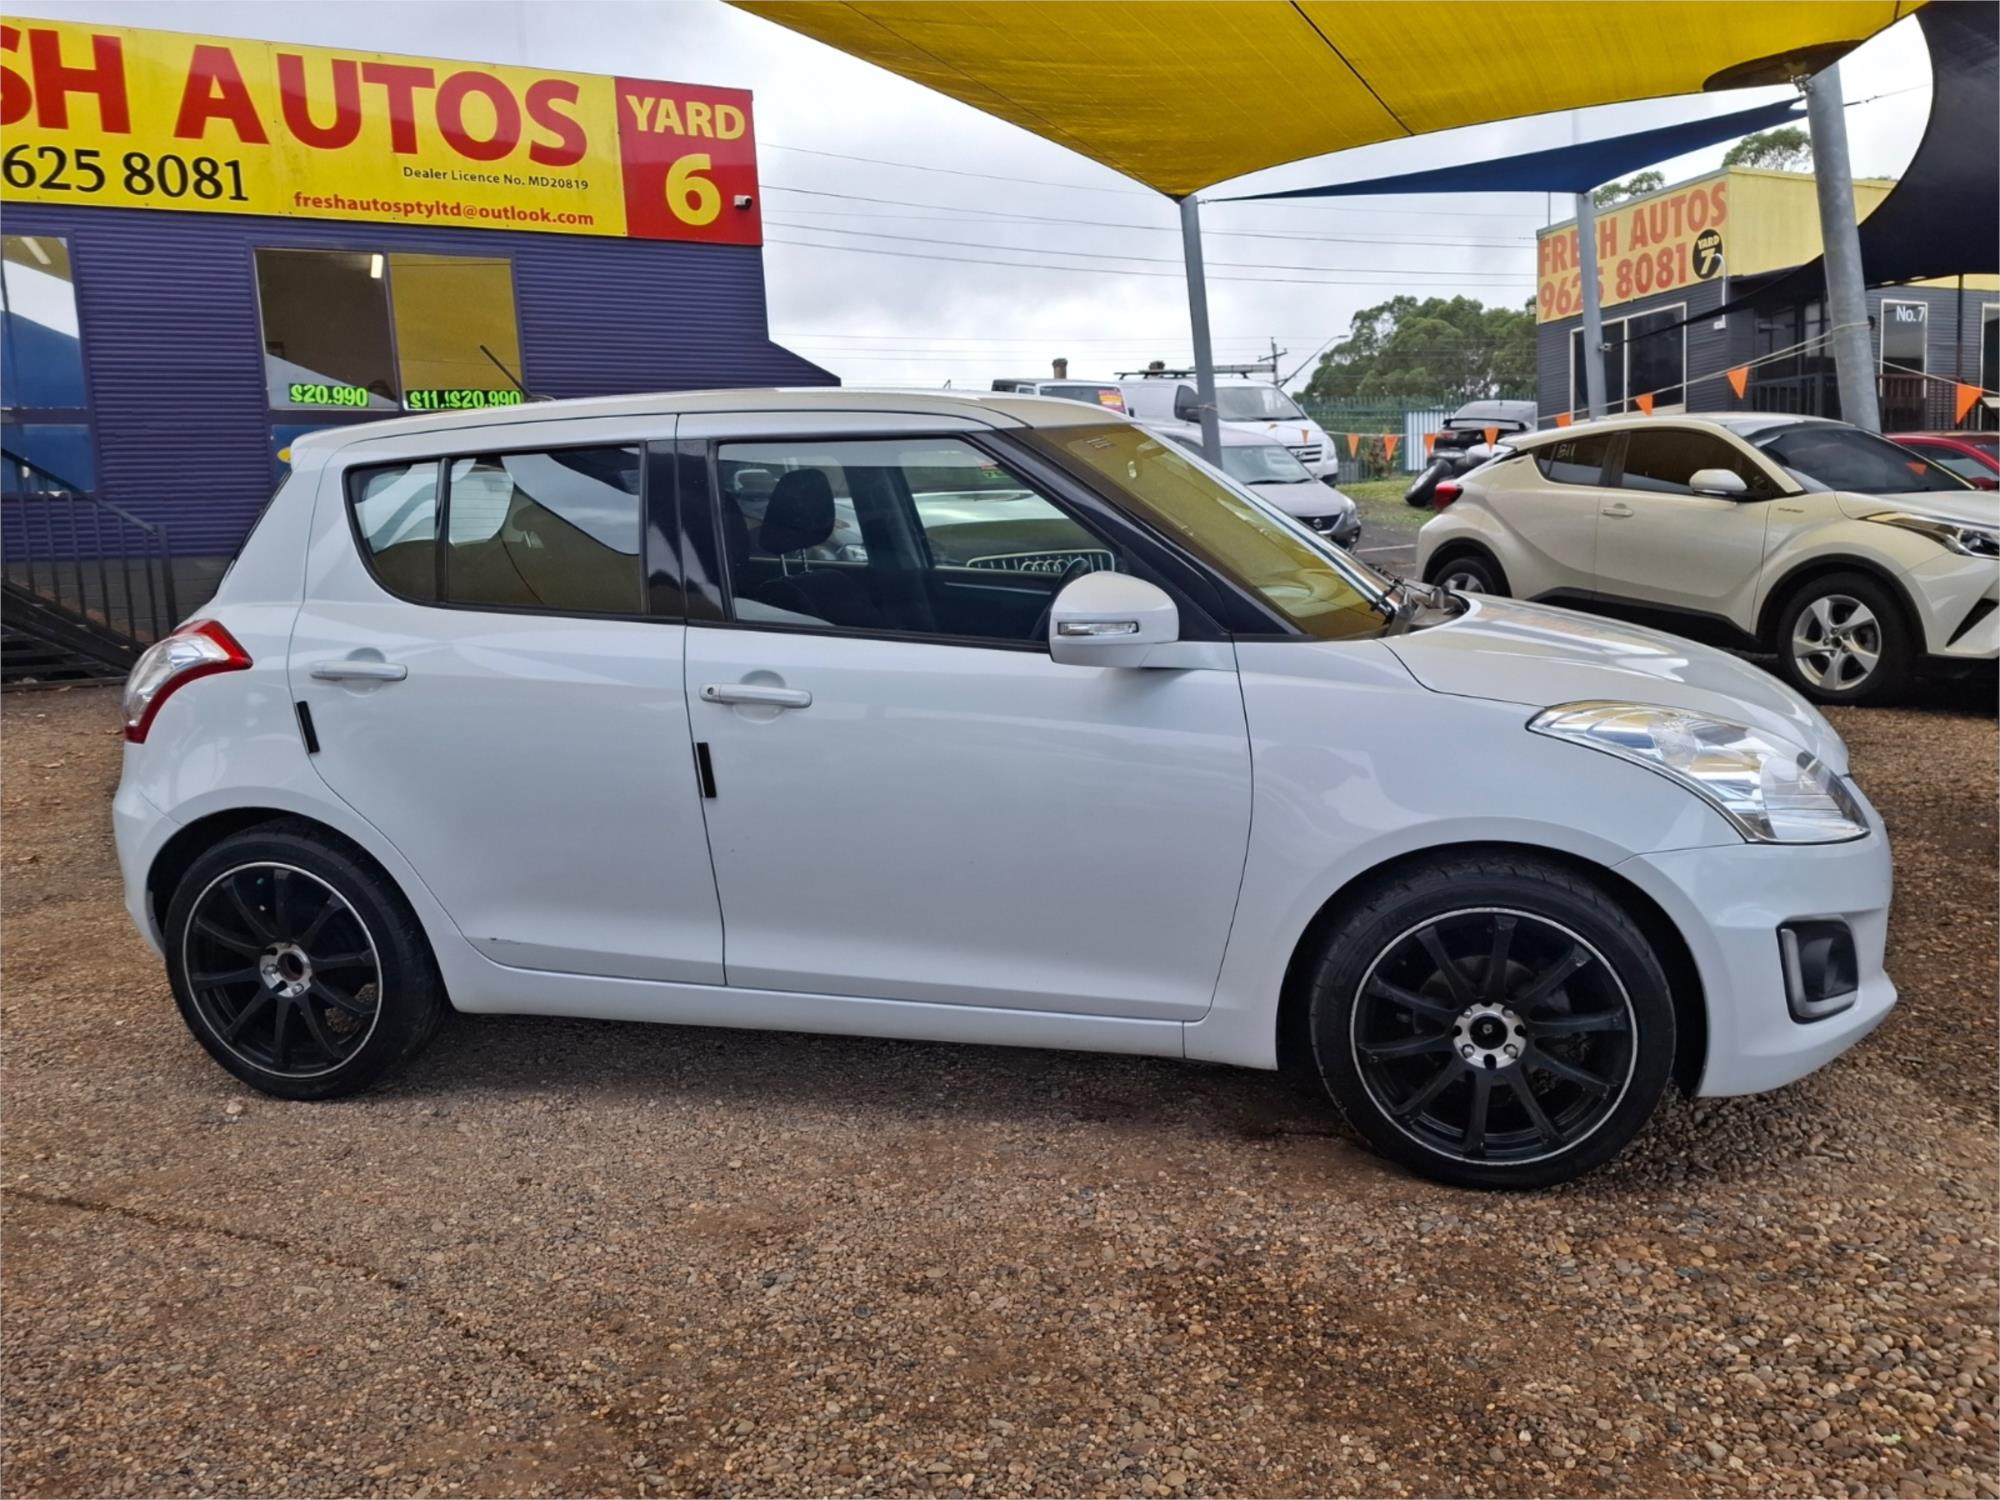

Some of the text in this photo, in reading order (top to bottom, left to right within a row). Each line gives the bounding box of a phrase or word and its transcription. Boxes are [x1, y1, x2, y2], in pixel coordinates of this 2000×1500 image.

[173, 44, 588, 167] AUTOS
[625, 94, 746, 140] YARD
[2, 144, 250, 201] 625 8081
[403, 166, 589, 191] Dealer Licence No. MD20819
[665, 153, 722, 226] 6
[294, 191, 595, 226] freshautosptyltd@outlook.com
[1539, 181, 1729, 277] FREH AUTOS
[1697, 234, 1720, 251] YARD
[1616, 242, 1687, 299] 8081
[1699, 248, 1716, 275] 7
[290, 384, 368, 407] $20.990
[410, 391, 449, 409] $11.
